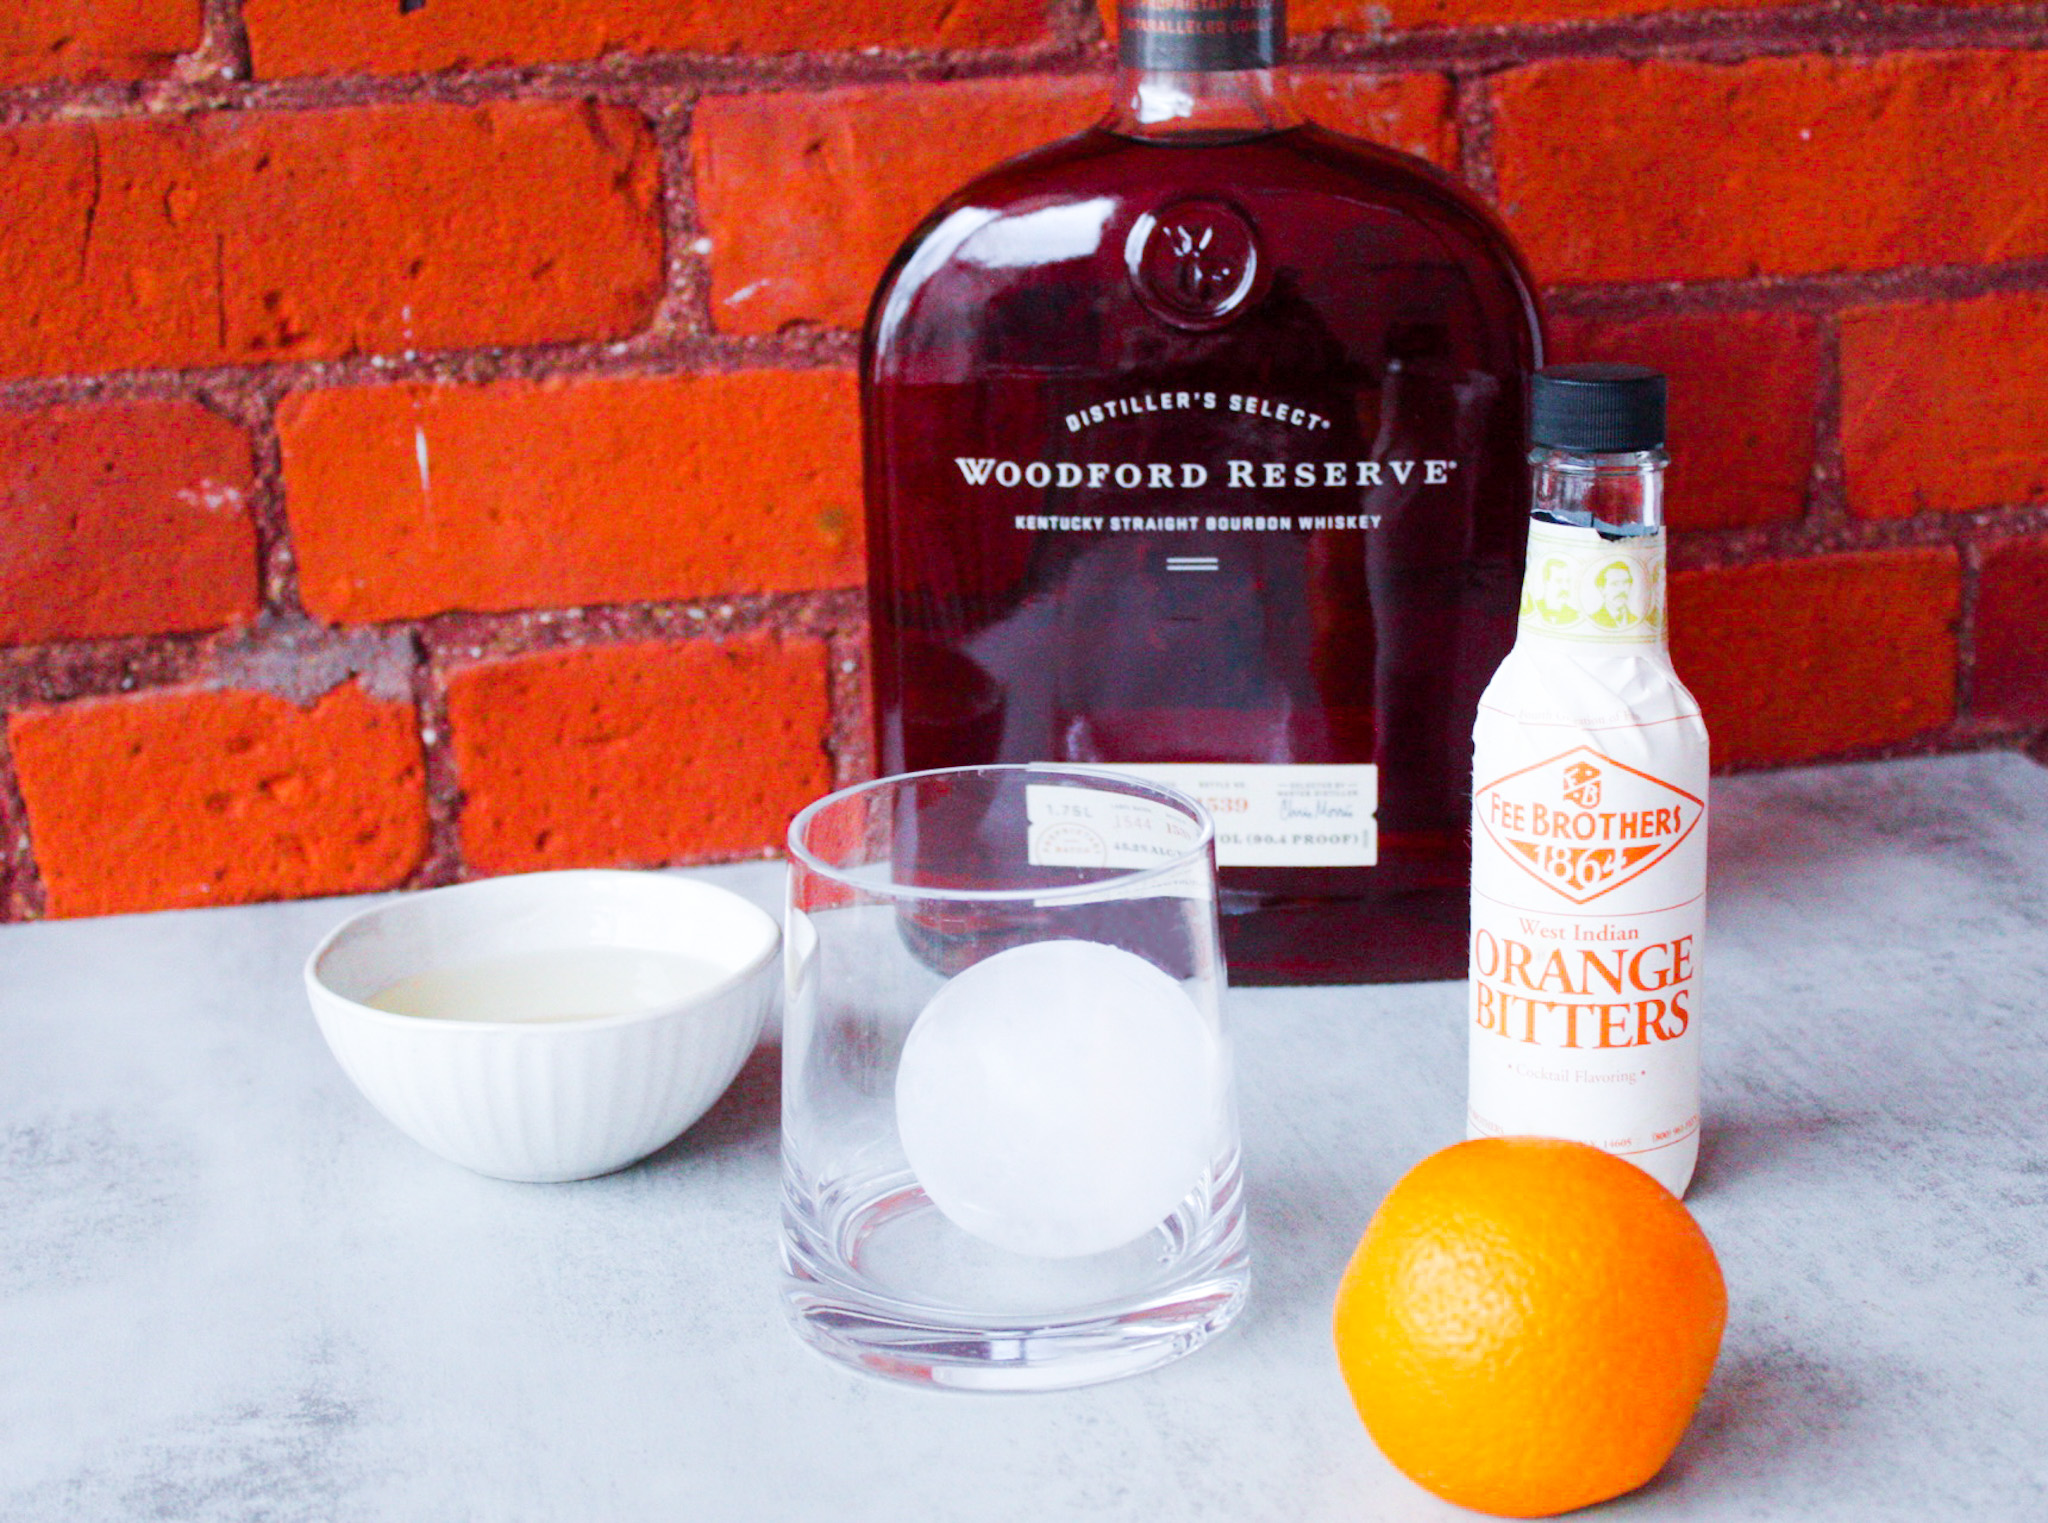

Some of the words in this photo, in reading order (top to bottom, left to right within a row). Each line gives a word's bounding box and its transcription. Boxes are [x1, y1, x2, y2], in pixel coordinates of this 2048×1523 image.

[1065, 391, 1217, 433] DISTILLER'S
[954, 457, 1208, 488] WOODFORD
[1227, 459, 1451, 488] RESERVE
[1015, 515, 1104, 532] KENTUCKY
[1109, 516, 1200, 532] STRAIGHT
[1205, 516, 1292, 532] BOURBON
[1299, 514, 1383, 531] WHISKEY
[1490, 791, 1526, 832] FEE
[1532, 803, 1682, 842] BROTHERS
[1534, 844, 1625, 886] 1864
[1518, 917, 1566, 940] West
[1573, 924, 1640, 942] Indian
[1475, 928, 1694, 996] ORANGE
[1475, 980, 1690, 1049] BITTERS
[1516, 1063, 1570, 1083] Cocktail
[1575, 1070, 1637, 1085] Flavoring
